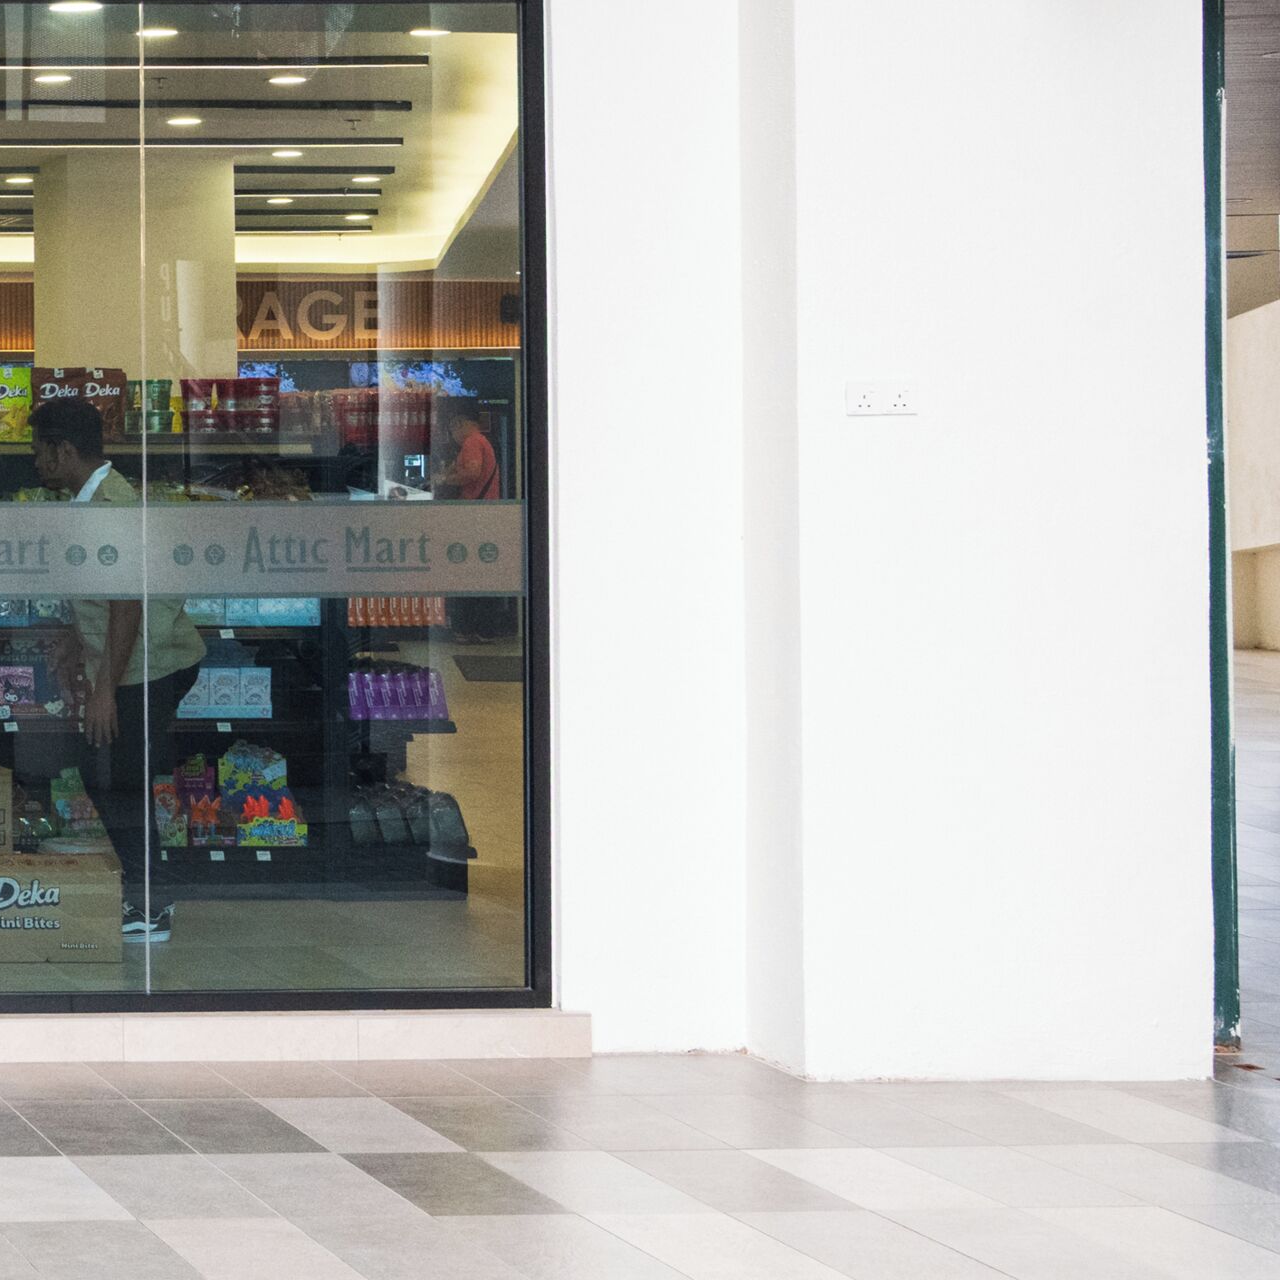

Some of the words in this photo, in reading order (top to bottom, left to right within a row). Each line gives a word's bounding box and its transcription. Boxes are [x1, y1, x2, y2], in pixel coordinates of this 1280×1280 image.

[40, 382, 79, 399] Deka
[83, 381, 121, 397] Deka
[242, 525, 329, 574] Attic
[344, 526, 431, 565] Mart
[23, 916, 61, 930] Bites
[60, 942, 78, 950] Mini
[79, 942, 99, 950] Bites
